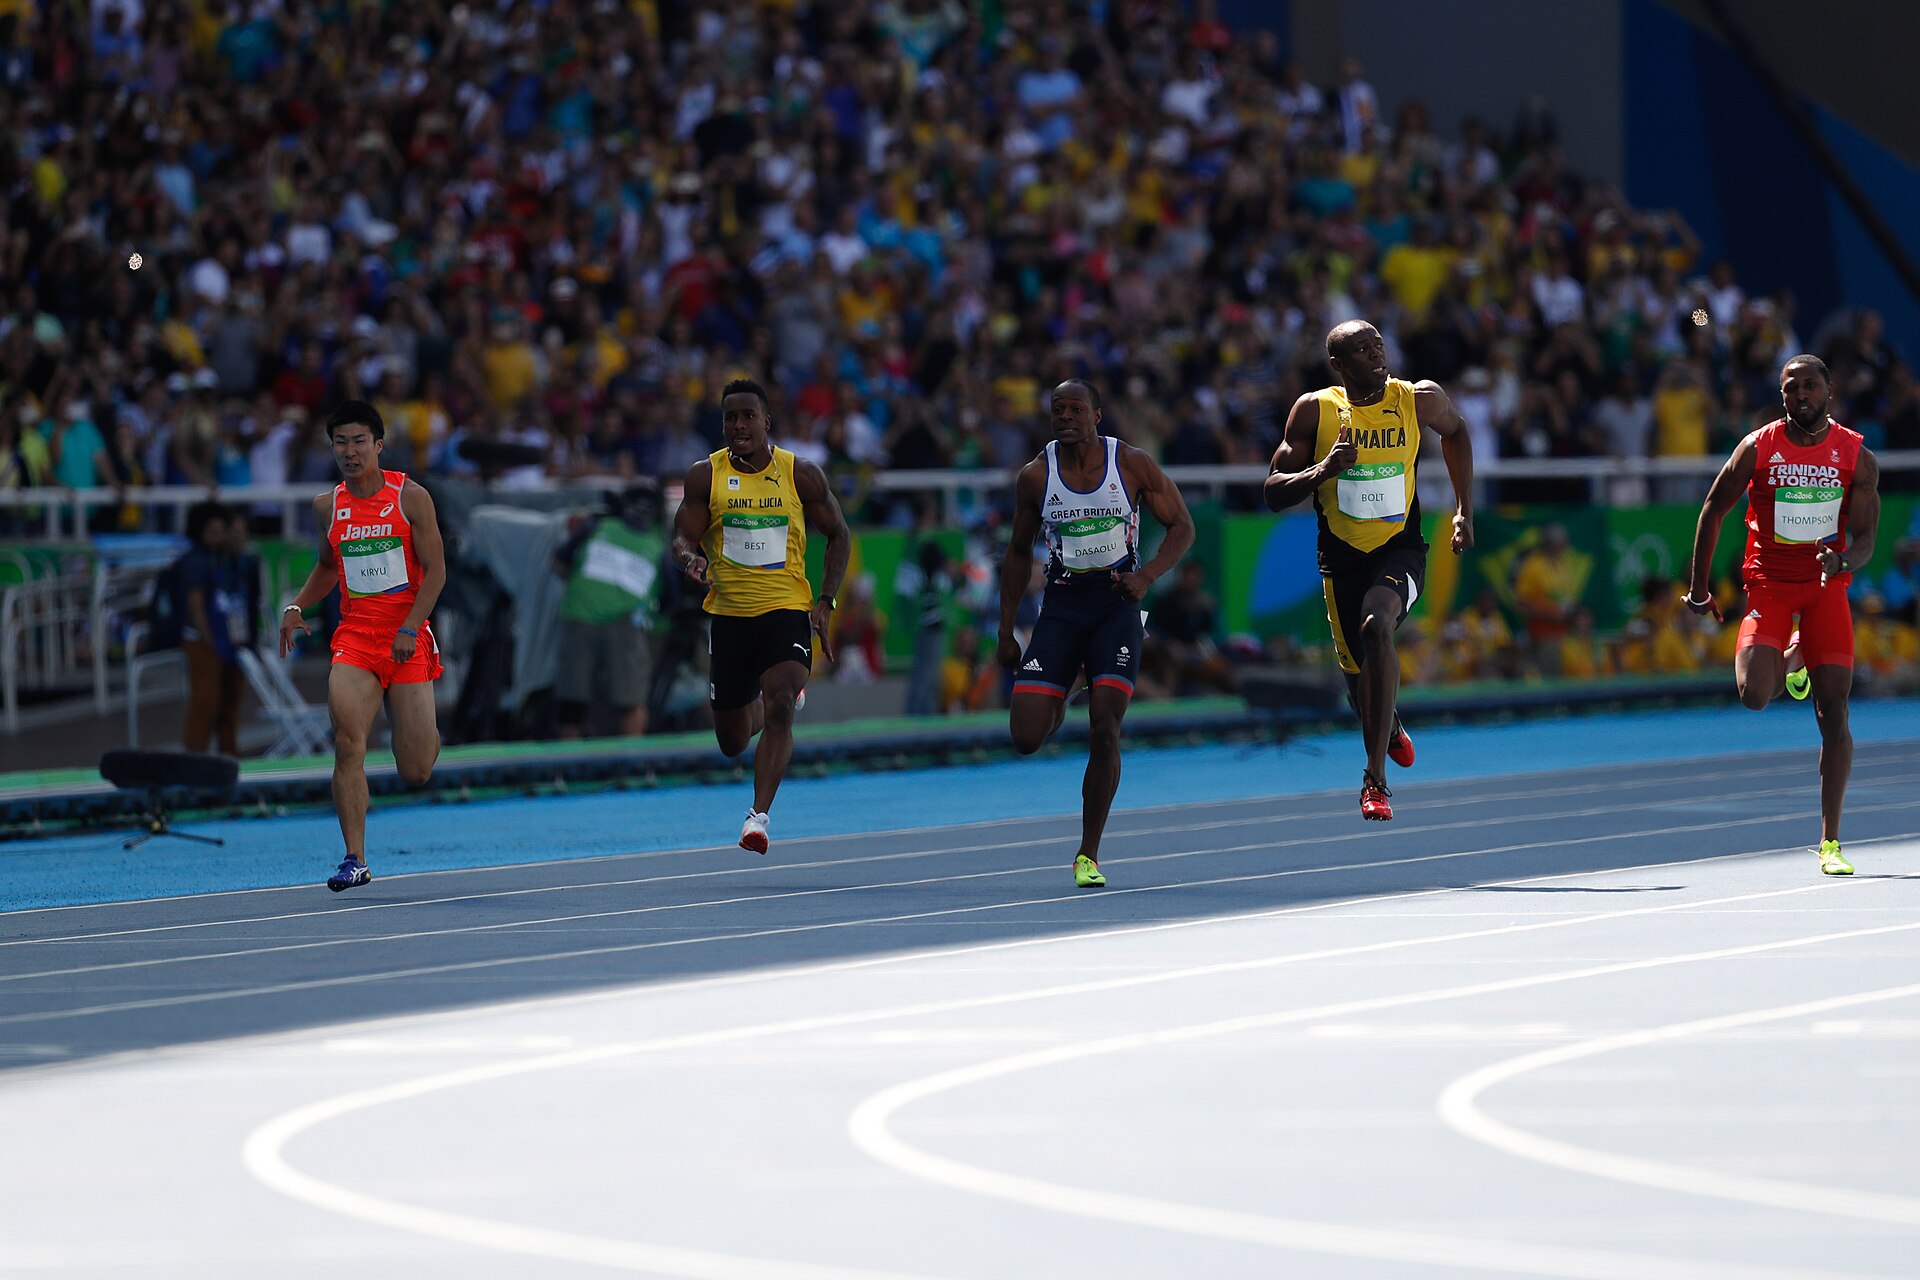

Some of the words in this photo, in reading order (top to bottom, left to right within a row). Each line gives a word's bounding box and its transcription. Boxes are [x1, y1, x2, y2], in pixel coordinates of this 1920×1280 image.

[1346, 427, 1406, 449] AMAICA
[1769, 464, 1839, 478] TRINIDAD
[728, 498, 753, 509] SAINT
[760, 497, 783, 508] LUCIA
[1361, 494, 1384, 502] BOLT
[1051, 509, 1081, 519] GREAT
[1084, 507, 1122, 517] BRITAIN
[1782, 515, 1833, 525] THOMPSON
[341, 524, 392, 540] Japan
[744, 542, 766, 550] BEST
[1075, 542, 1117, 557] DASAOLU
[361, 567, 386, 577] KIRYU
